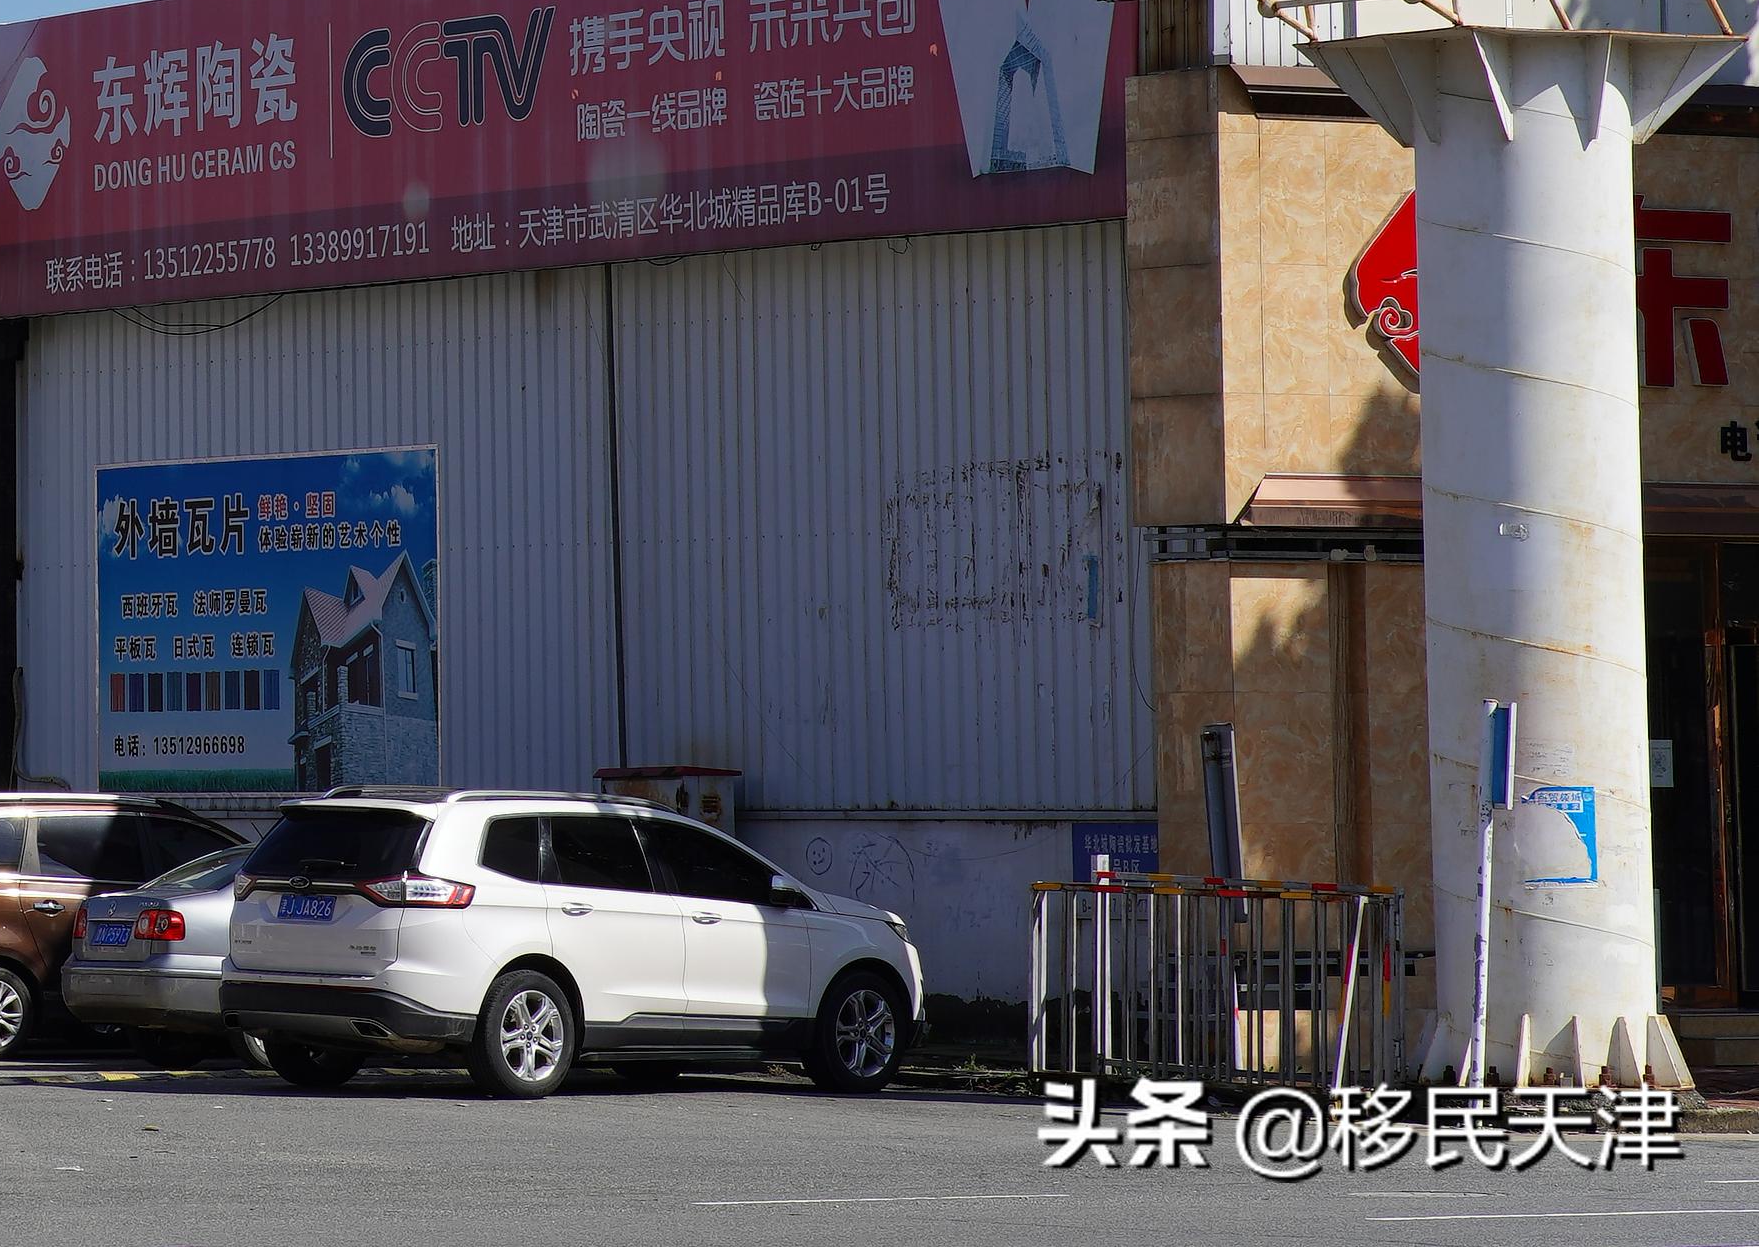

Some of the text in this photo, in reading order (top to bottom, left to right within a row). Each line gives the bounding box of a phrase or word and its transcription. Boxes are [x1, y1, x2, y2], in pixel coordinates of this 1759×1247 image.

[93, 32, 298, 144] 东辉陶瓷
[342, 5, 557, 138] CCTV
[577, 65, 915, 142] 陶瓷一线品牌 瓷砖十大品牌
[94, 157, 152, 192] DONG
[157, 153, 186, 184] HU
[289, 220, 429, 267] 13389917191
[113, 494, 250, 560] 外墙瓦片
[258, 519, 402, 553] 体验崭新的艺术个性
[121, 588, 268, 620] 西班牙瓦 法师罗曼瓦
[114, 632, 276, 662] 平板瓦 日式瓦 连锁瓦
